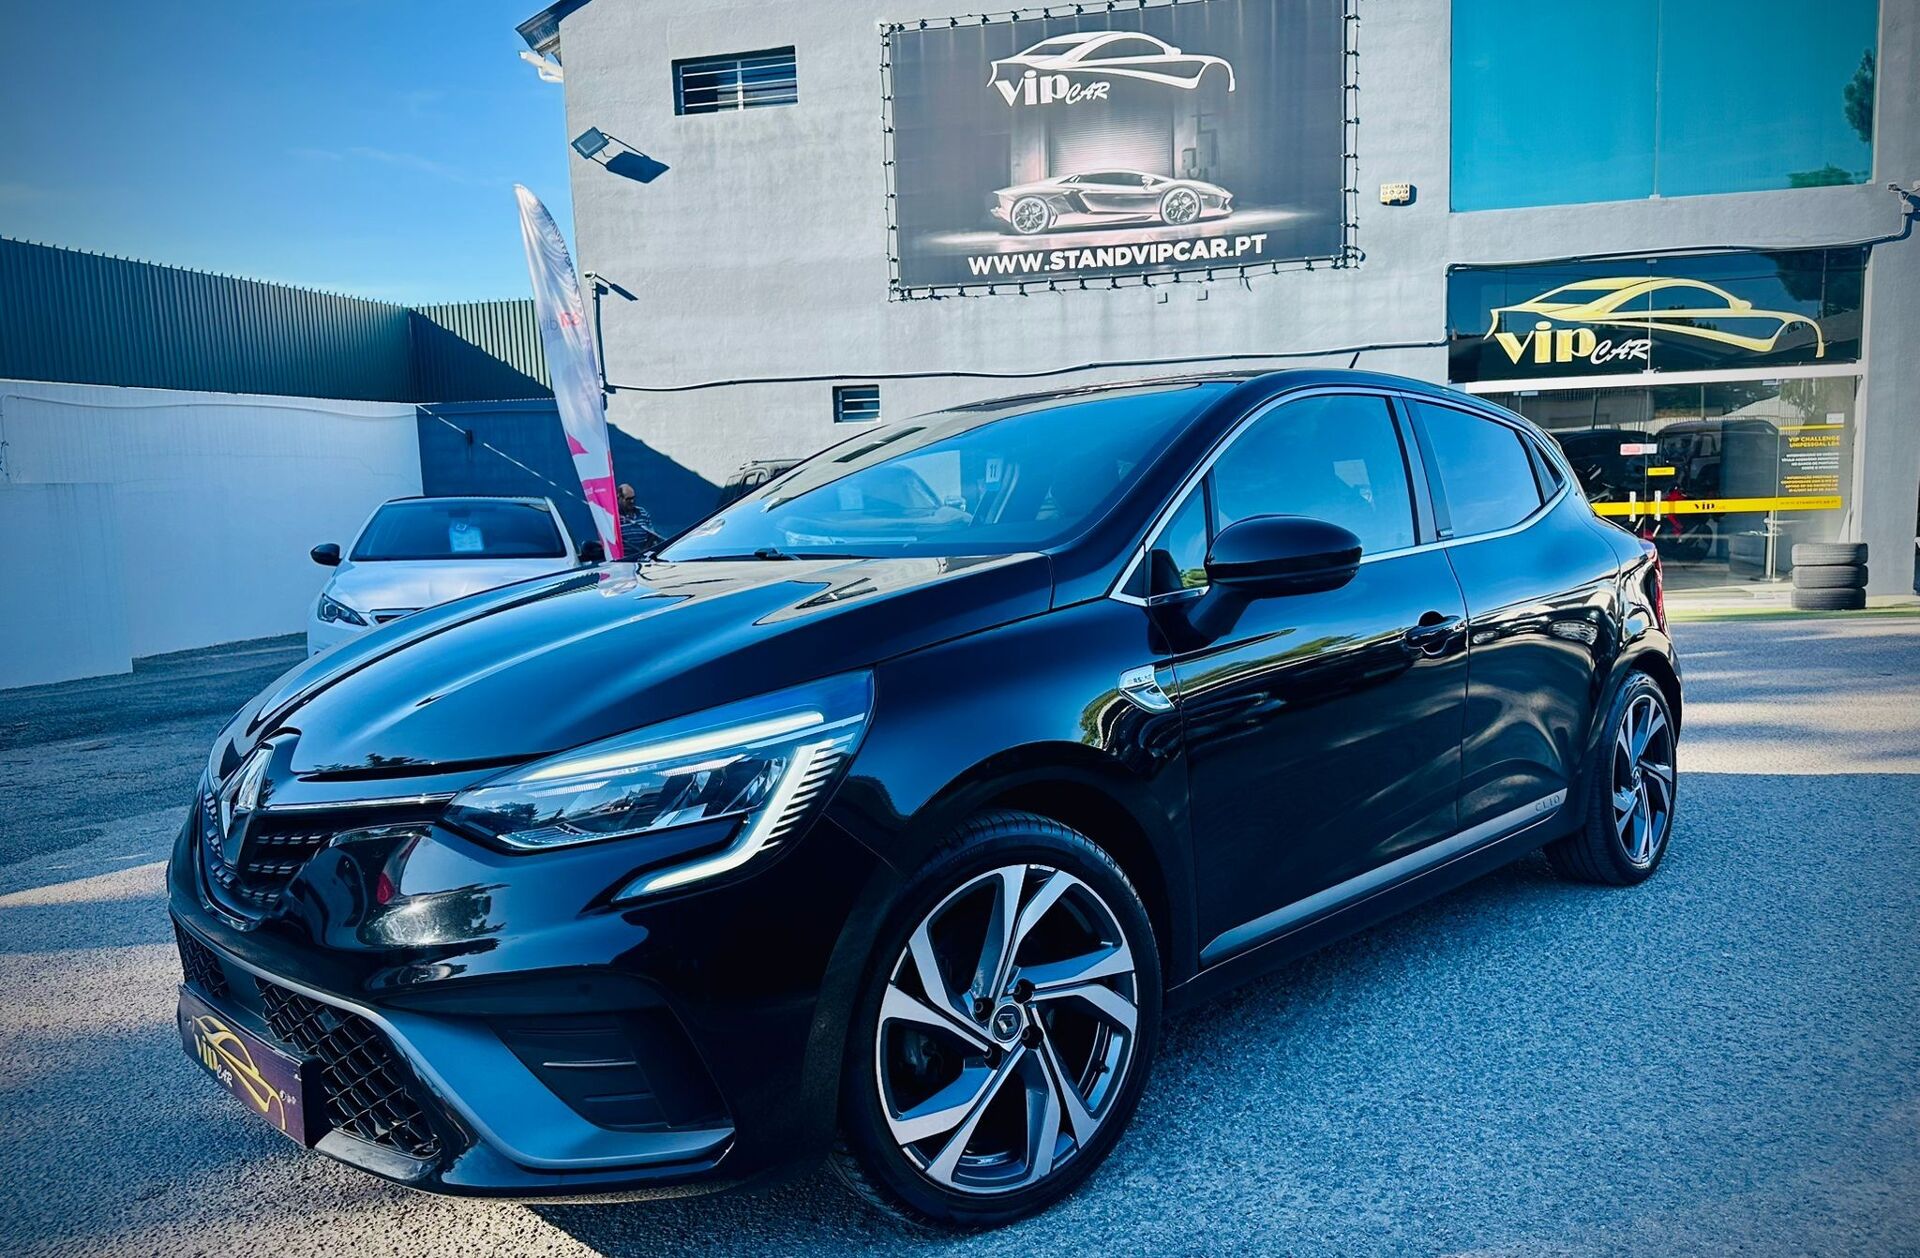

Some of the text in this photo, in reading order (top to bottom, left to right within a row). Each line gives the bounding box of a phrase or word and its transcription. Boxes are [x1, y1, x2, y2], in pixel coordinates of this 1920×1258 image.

[994, 69, 1111, 107] vip CAR
[967, 233, 1268, 276] WWW.STANDVIPCAR.PT
[1494, 320, 1653, 365] vip CAR
[1535, 795, 1560, 812] CLIO
